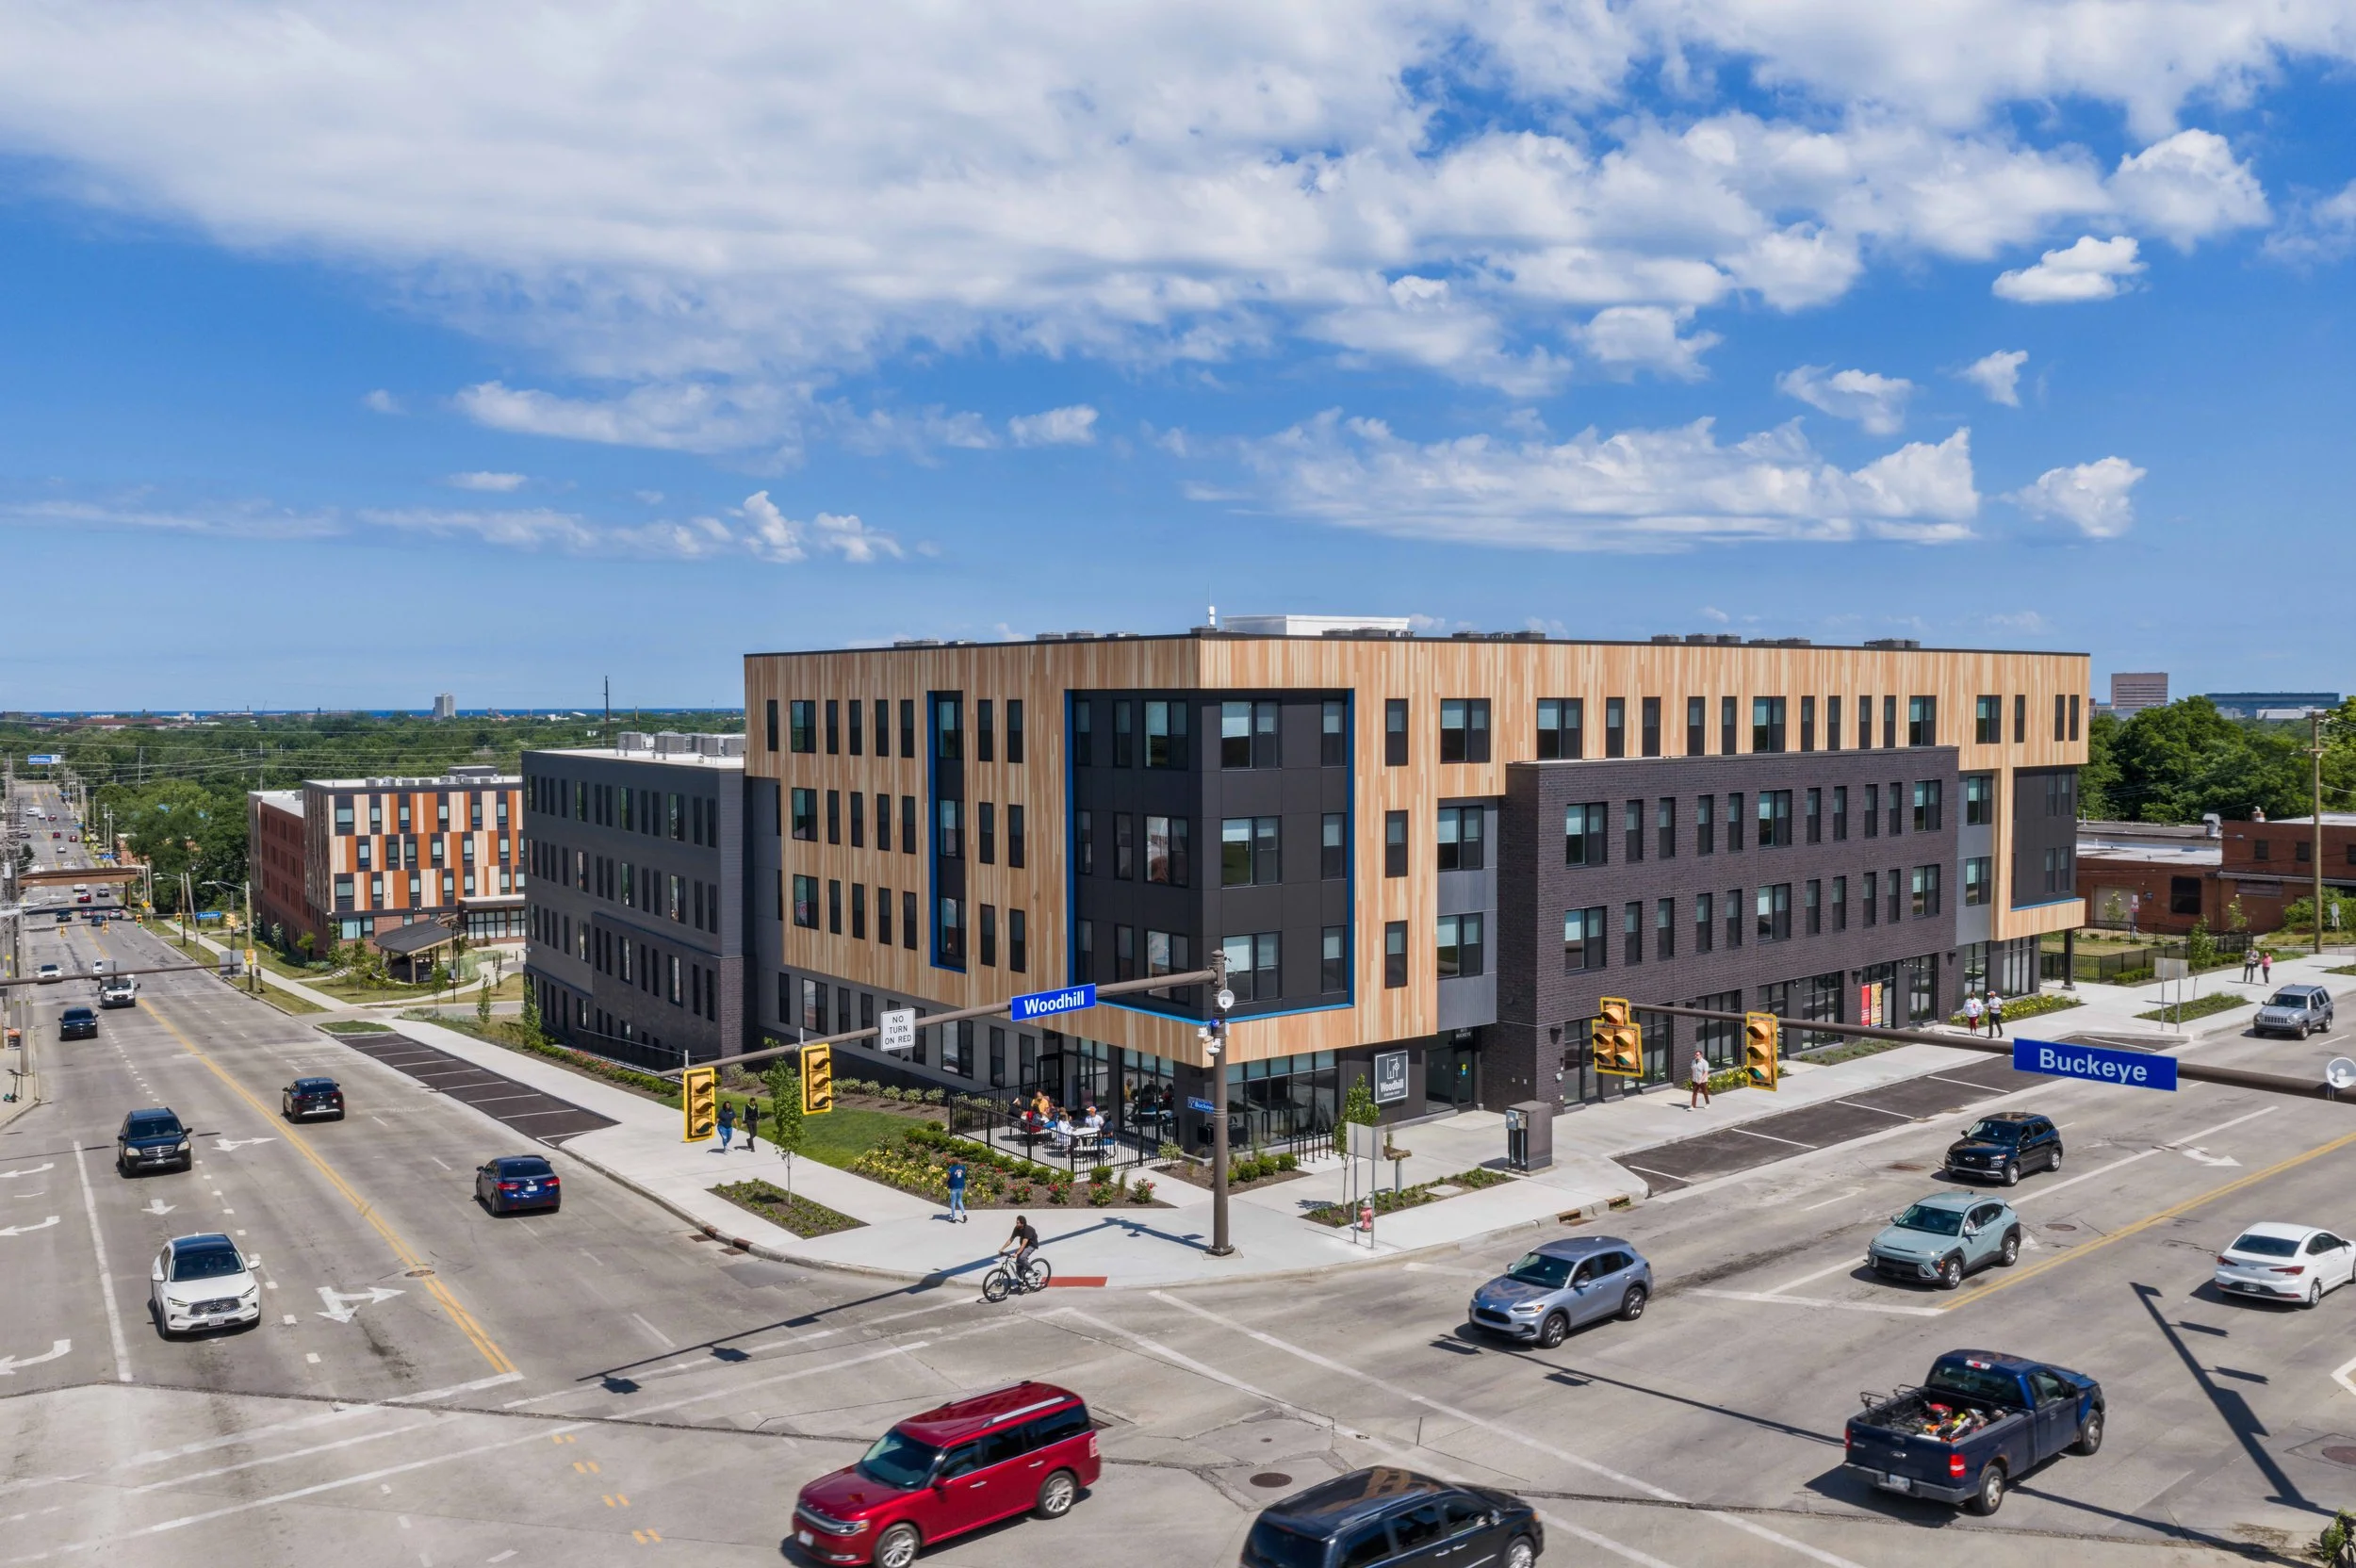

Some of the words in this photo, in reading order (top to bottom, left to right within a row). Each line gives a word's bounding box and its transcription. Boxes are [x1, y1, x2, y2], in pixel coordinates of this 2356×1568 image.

[1023, 990, 1085, 1015] Woodhill
[892, 1015, 905, 1023] NO
[889, 1025, 908, 1034] TURN
[897, 1034, 912, 1043] RED
[2038, 1047, 2148, 1084] Buckeye
[1380, 1078, 1404, 1093] Woodhill
